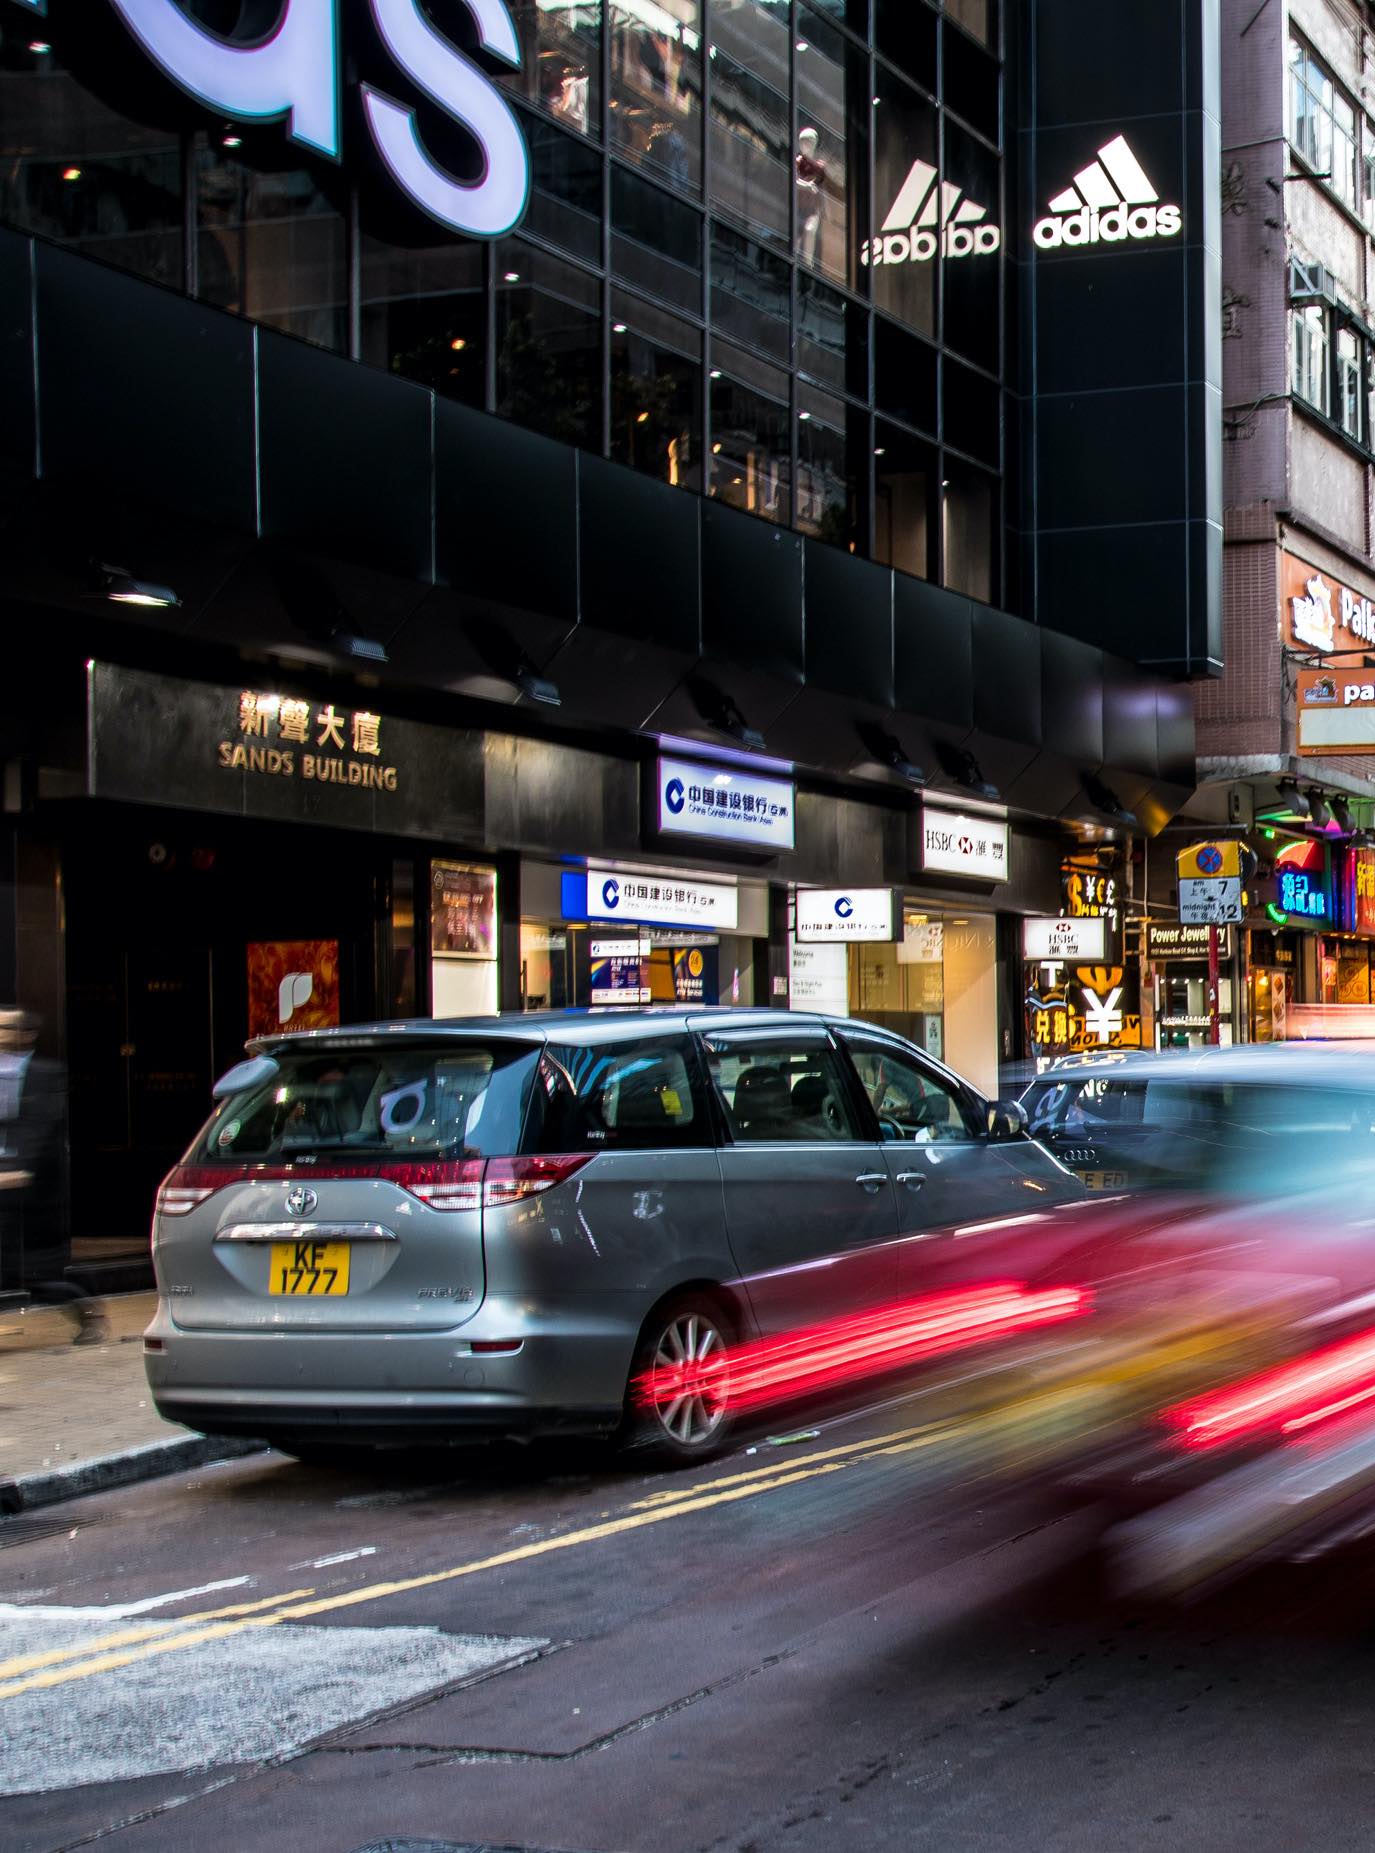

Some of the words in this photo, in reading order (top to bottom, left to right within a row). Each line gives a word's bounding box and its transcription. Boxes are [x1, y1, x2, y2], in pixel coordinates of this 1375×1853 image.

[1033, 202, 1182, 250] adidas
[218, 741, 295, 777] SANDS
[302, 754, 398, 792] BUILDING
[926, 829, 956, 853] HSBC
[1218, 880, 1229, 896] 7
[1182, 903, 1216, 912] midnight
[1048, 933, 1079, 944] HSBC
[1150, 927, 1179, 944] Power
[1181, 925, 1226, 944] Jewellry
[294, 1242, 327, 1271] KF
[281, 1267, 338, 1295] 1777
